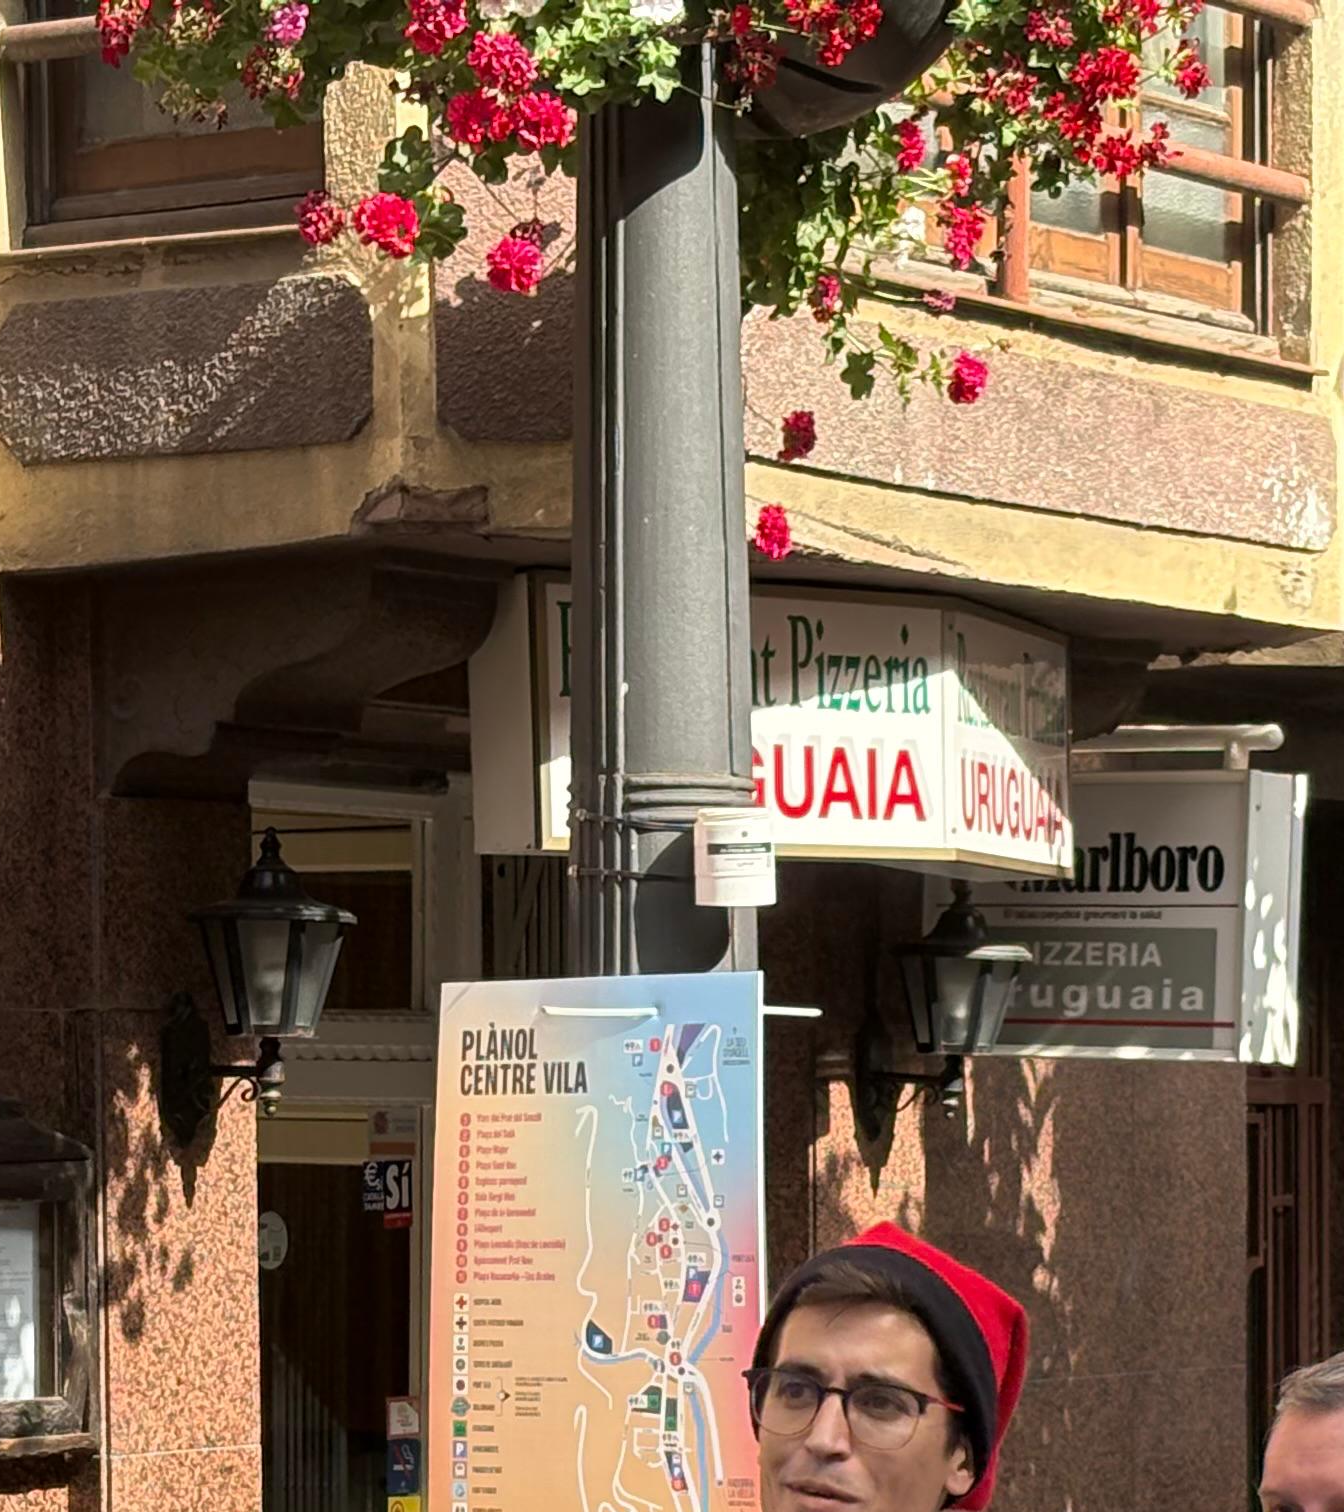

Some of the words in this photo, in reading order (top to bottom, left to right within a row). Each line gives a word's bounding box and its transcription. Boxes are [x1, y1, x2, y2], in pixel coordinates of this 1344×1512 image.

[787, 614, 931, 715] Pizzeria
[1004, 833, 1225, 893] arlboro
[1022, 942, 1162, 968] IZZERIA
[461, 1022, 538, 1061] PLÀNOL
[460, 1063, 536, 1096] CENTRE
[543, 1061, 588, 1094] VILA
